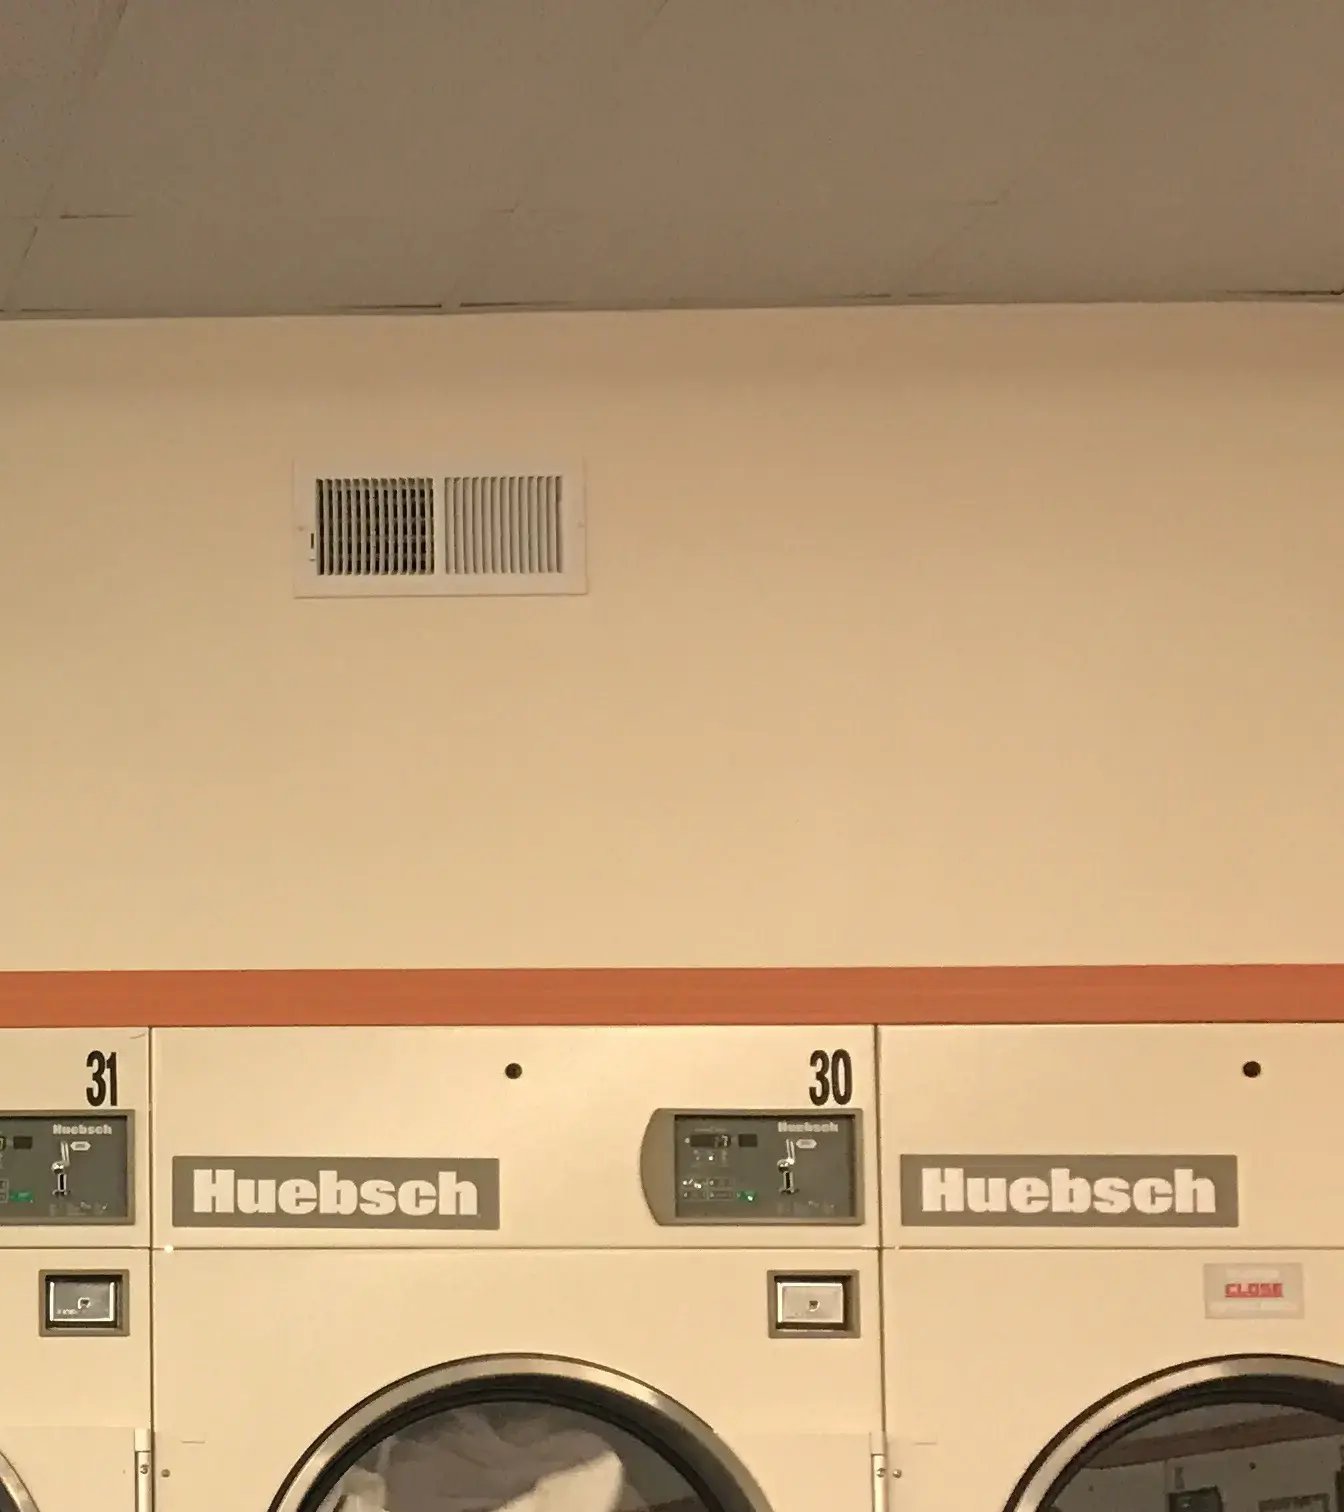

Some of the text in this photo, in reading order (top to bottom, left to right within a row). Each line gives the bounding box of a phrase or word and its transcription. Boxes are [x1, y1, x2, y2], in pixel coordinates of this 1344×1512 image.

[86, 1050, 118, 1107] 31
[809, 1049, 852, 1107] 30
[193, 1168, 478, 1216] Huebsch
[921, 1167, 1216, 1214] Huebsch
